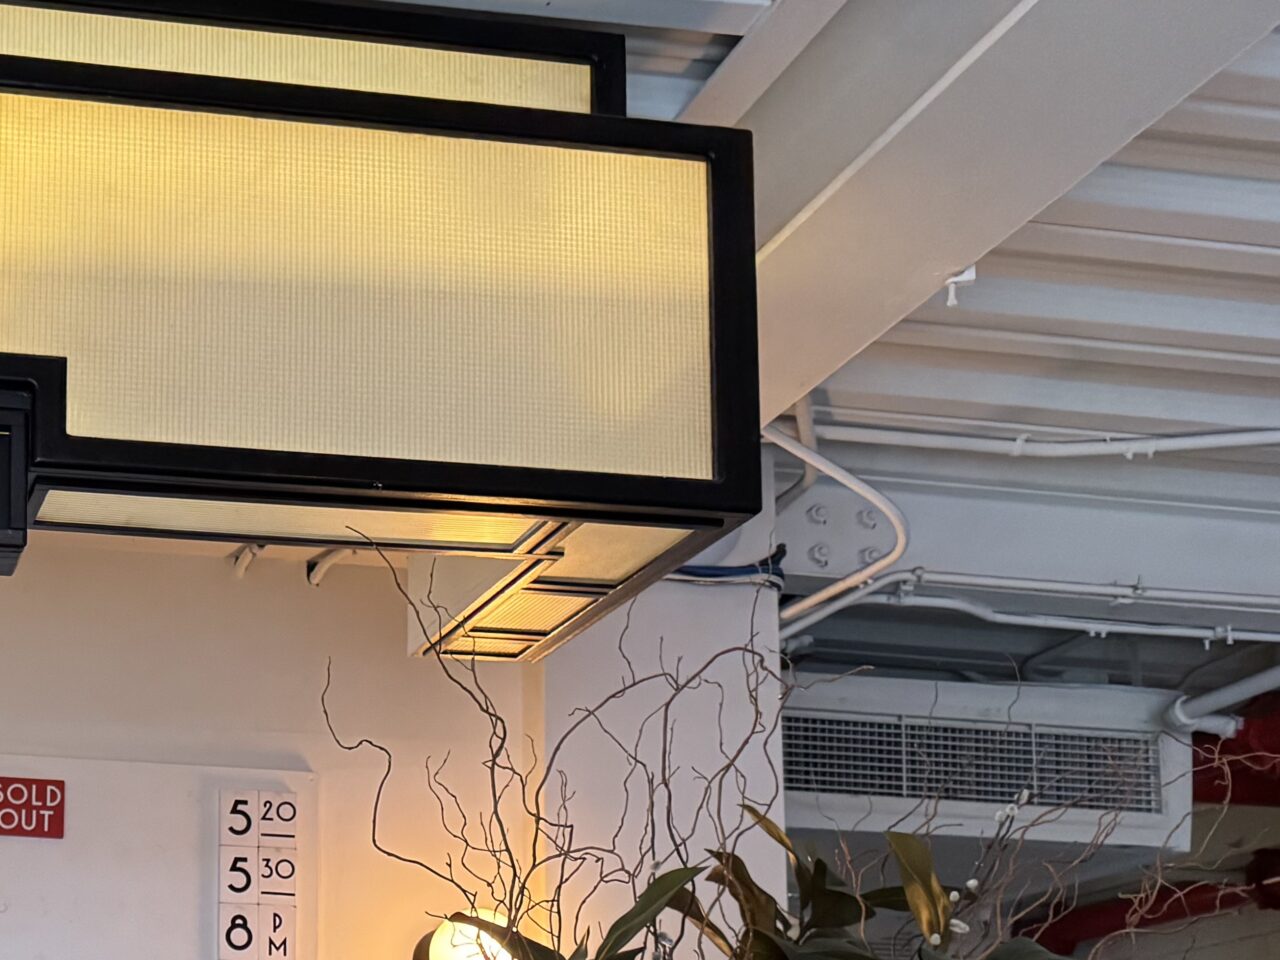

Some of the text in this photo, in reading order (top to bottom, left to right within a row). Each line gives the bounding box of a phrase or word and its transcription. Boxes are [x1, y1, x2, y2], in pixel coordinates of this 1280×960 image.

[228, 799, 297, 836] 5 20
[227, 857, 295, 893] 5 30
[225, 914, 253, 951] 8
